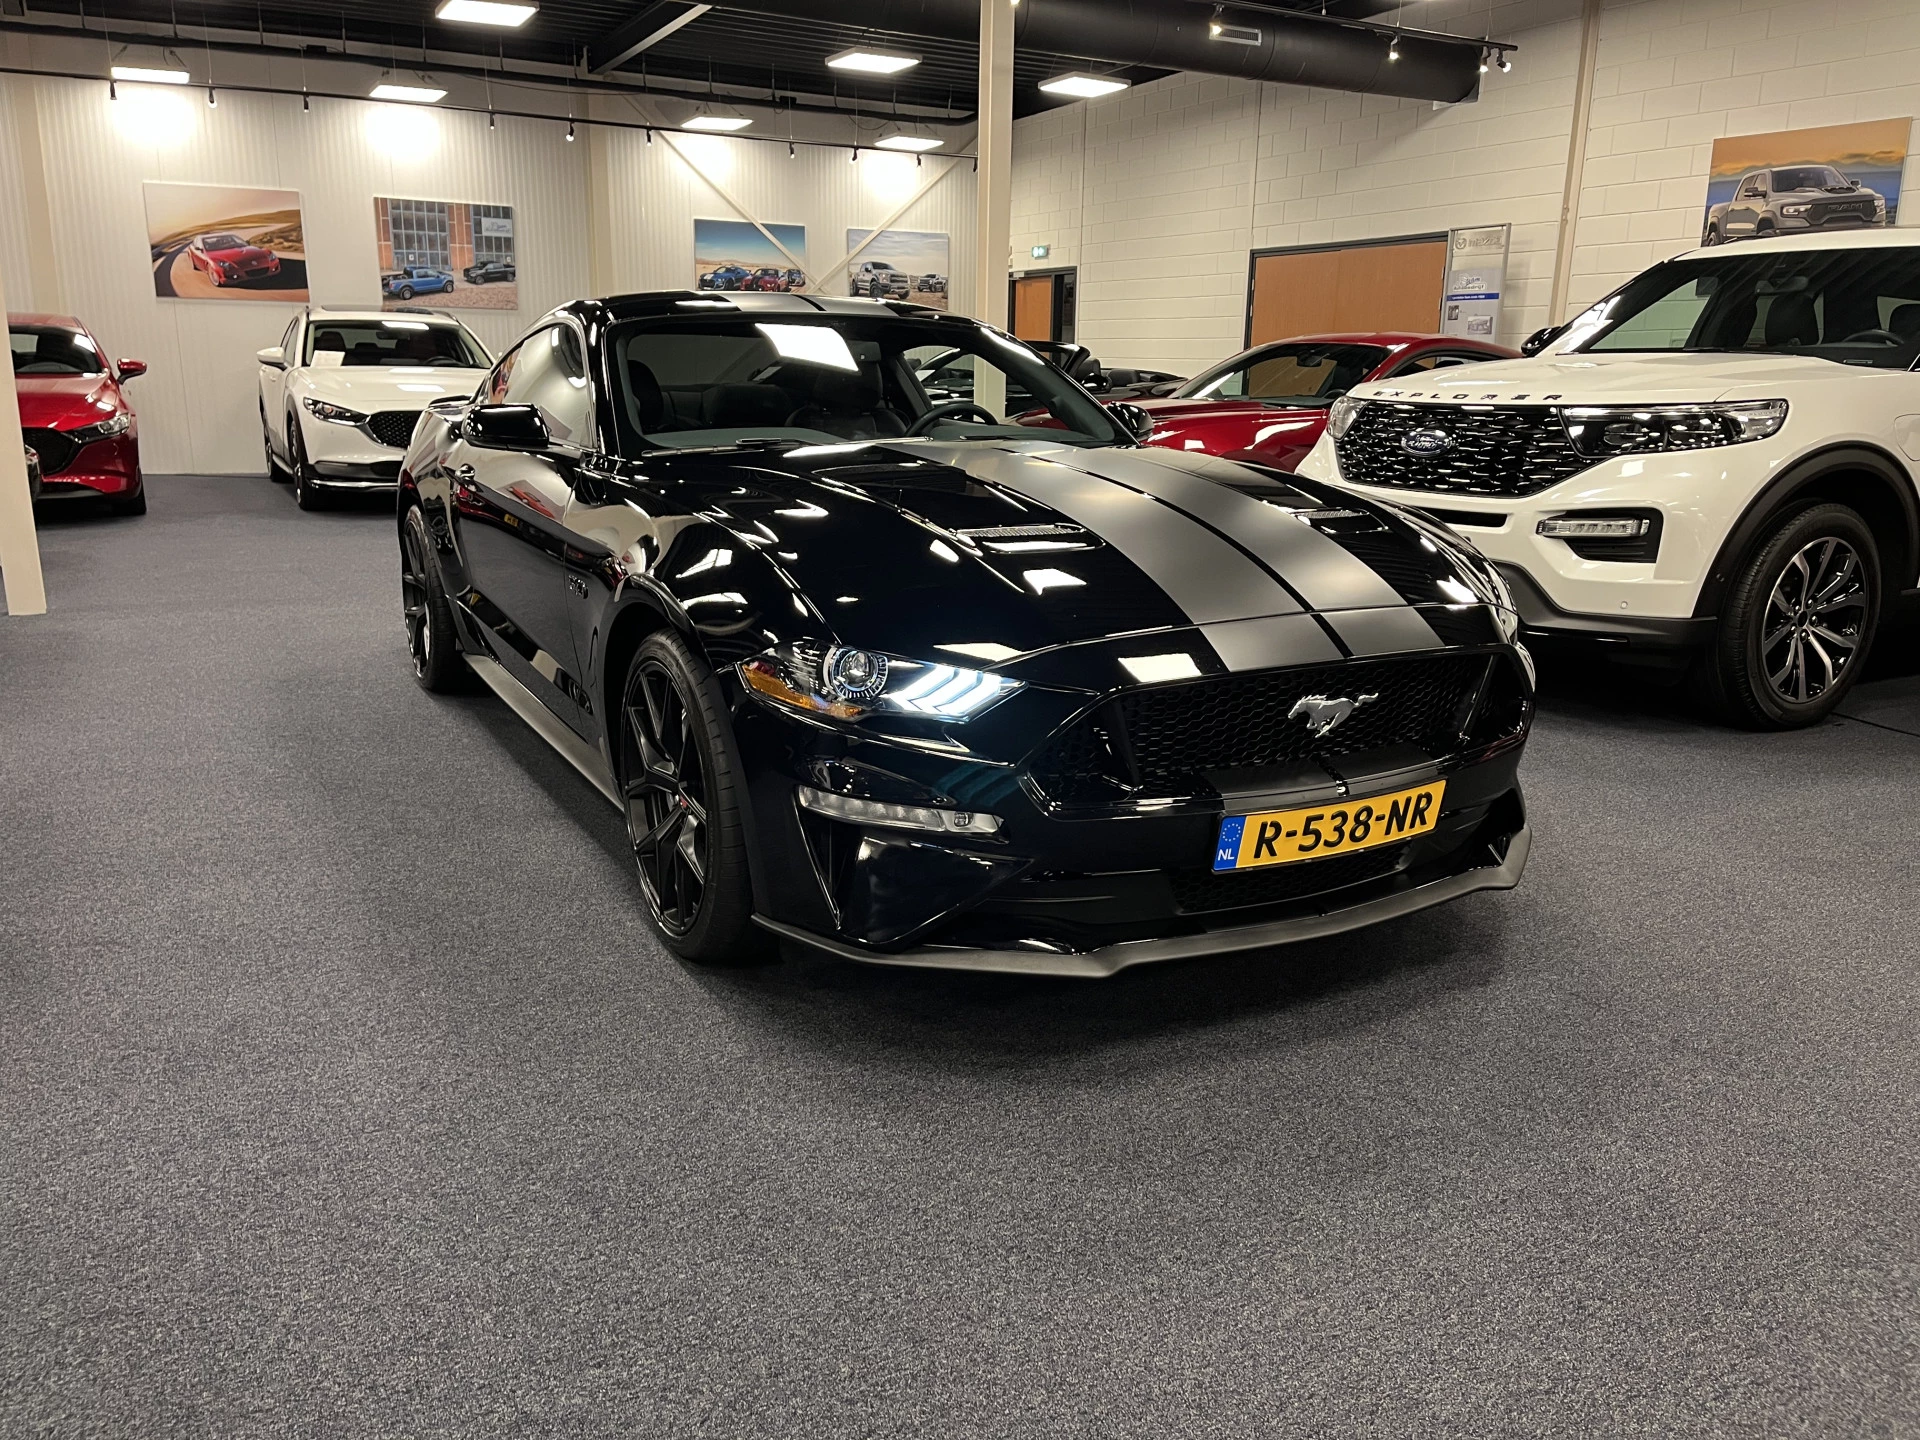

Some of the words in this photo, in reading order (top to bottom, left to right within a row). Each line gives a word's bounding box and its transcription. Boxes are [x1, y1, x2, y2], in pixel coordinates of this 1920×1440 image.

[1373, 391, 1562, 400] EXPLORER
[1253, 792, 1432, 858] R-538-NR
[1218, 849, 1234, 861] NL
